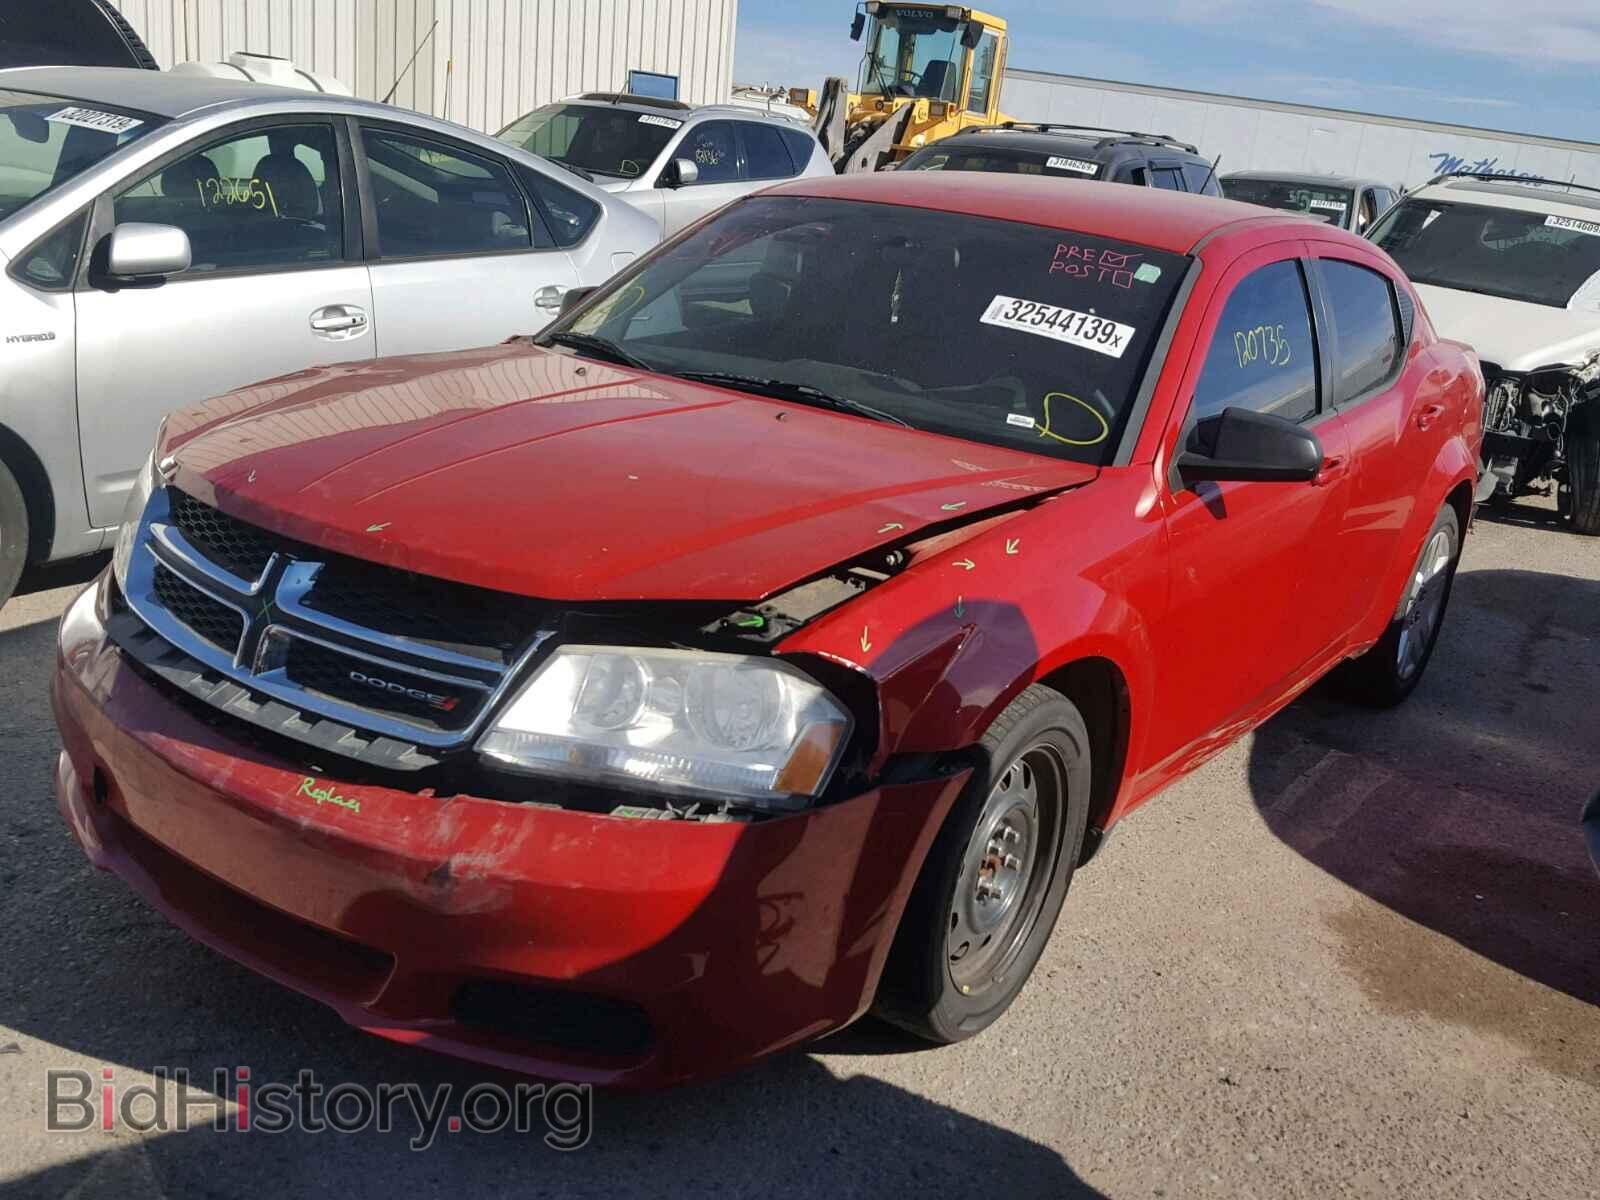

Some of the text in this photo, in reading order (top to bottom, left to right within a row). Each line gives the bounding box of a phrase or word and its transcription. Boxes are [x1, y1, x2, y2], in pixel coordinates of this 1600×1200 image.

[895, 8, 934, 18] VOLVO
[1054, 244, 1096, 261] PRE
[1048, 261, 1113, 283] POST
[350, 671, 446, 708] DODGE
